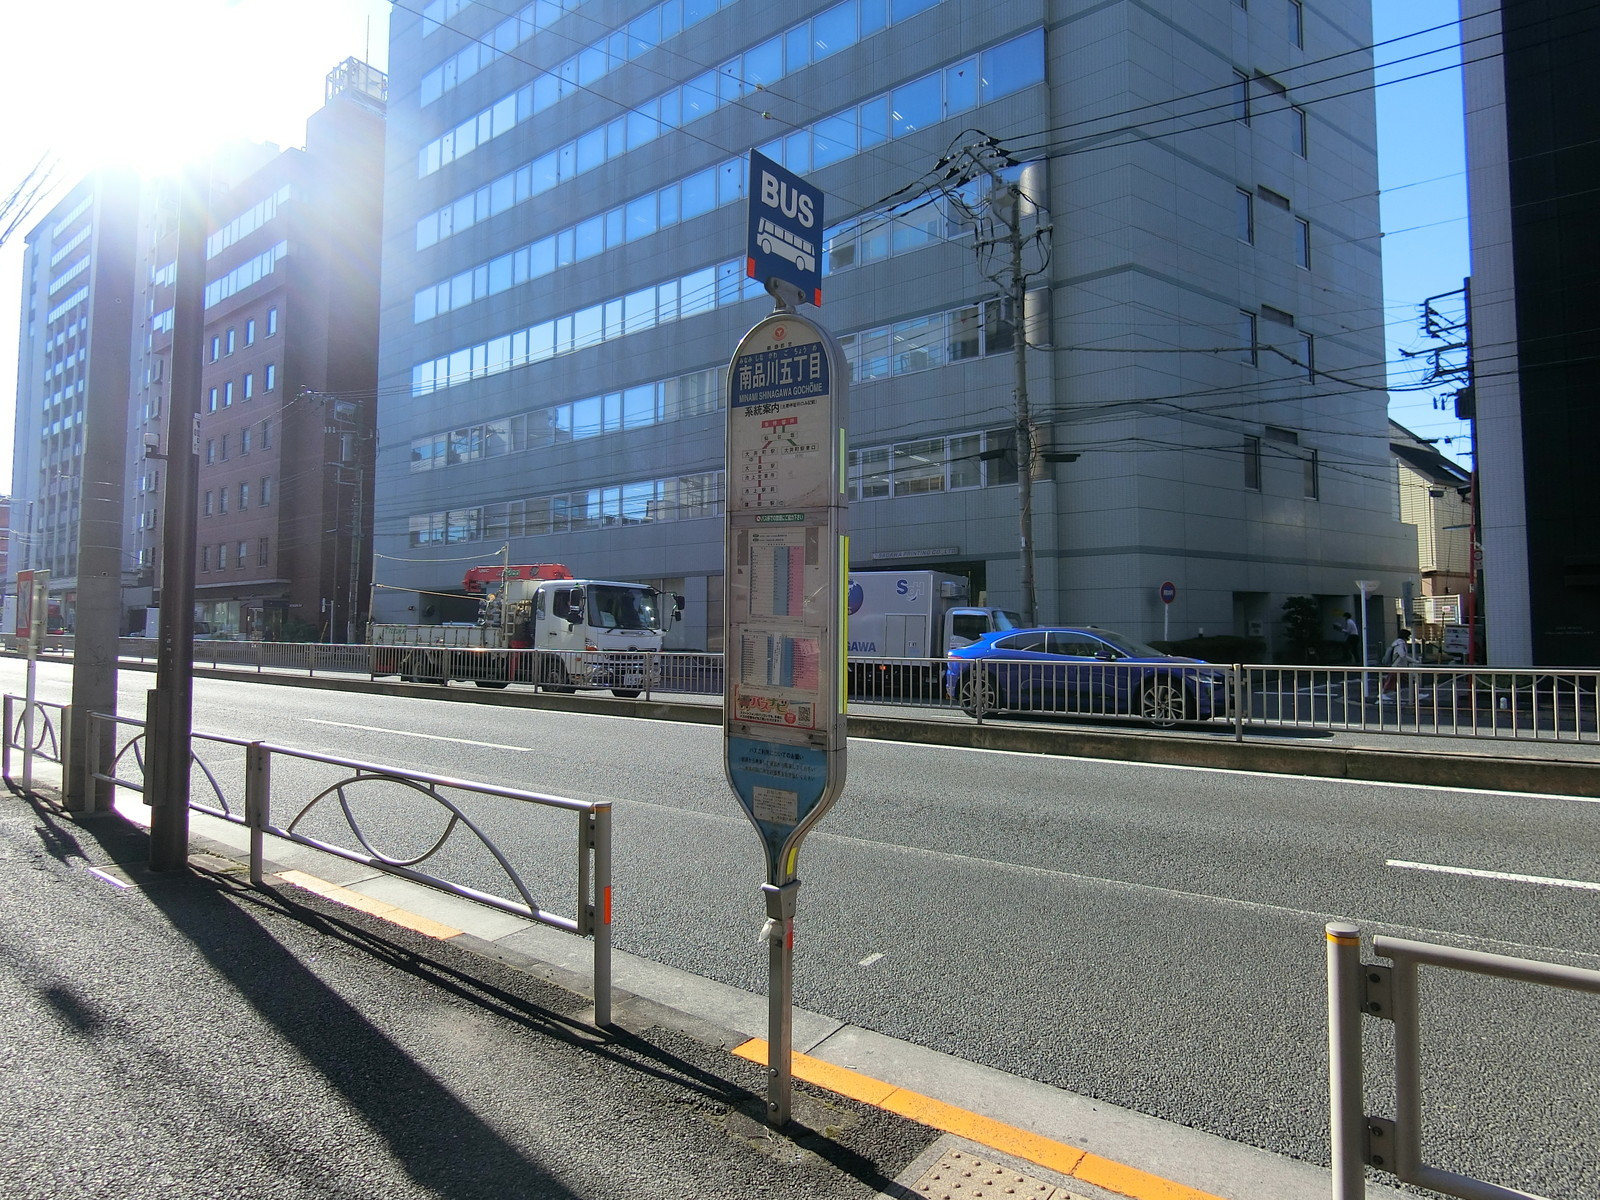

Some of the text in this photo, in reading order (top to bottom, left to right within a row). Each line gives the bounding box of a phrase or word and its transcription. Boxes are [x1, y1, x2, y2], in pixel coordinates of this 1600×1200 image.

[761, 170, 814, 228] BUS
[739, 352, 821, 391] 南品川五丁目
[738, 392, 758, 403] MINAMI
[758, 387, 792, 401] SHINAGAWA
[744, 402, 780, 417] 系統案内
[750, 697, 788, 715] バスナビ
